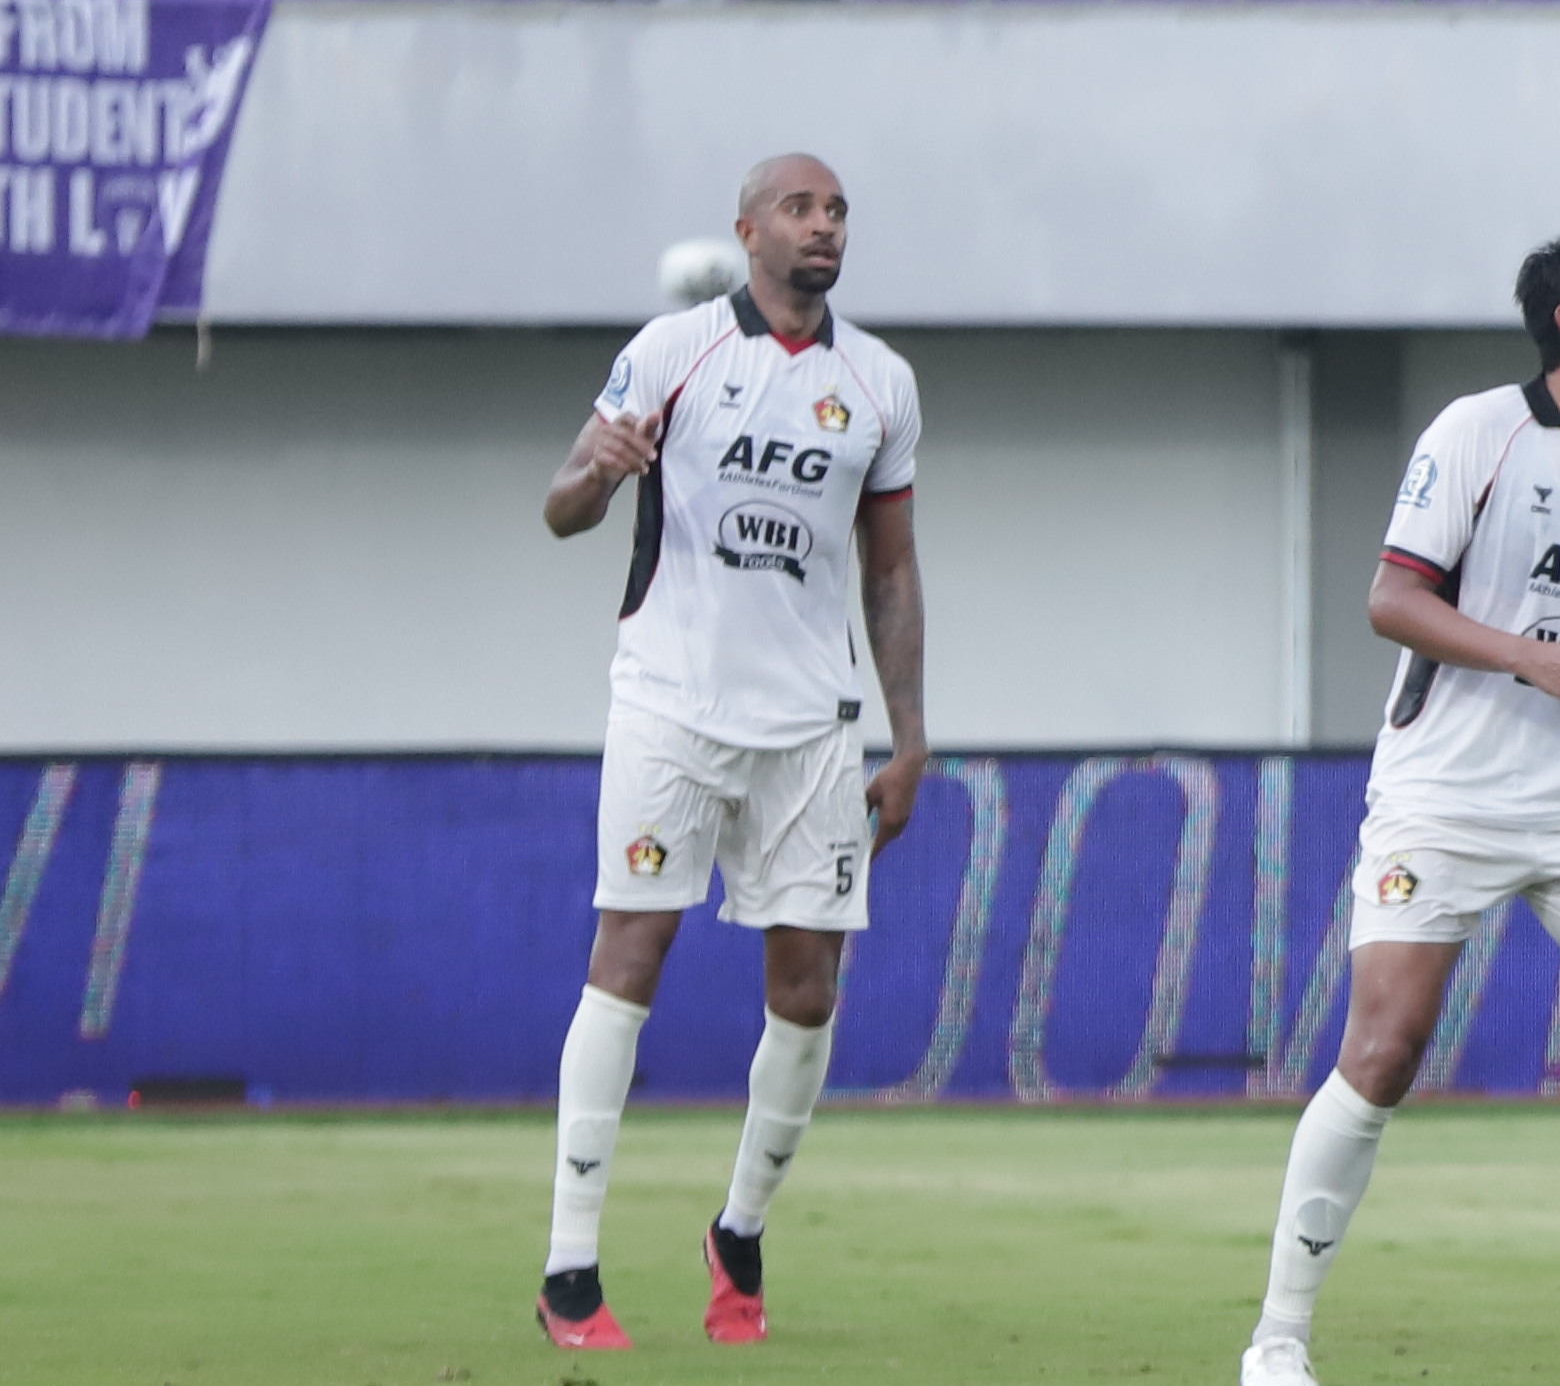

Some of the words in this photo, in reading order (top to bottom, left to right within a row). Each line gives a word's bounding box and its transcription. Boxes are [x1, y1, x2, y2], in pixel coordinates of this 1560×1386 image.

[718, 435, 833, 483] AFG
[736, 513, 801, 552] WBI
[835, 854, 854, 896] 5
